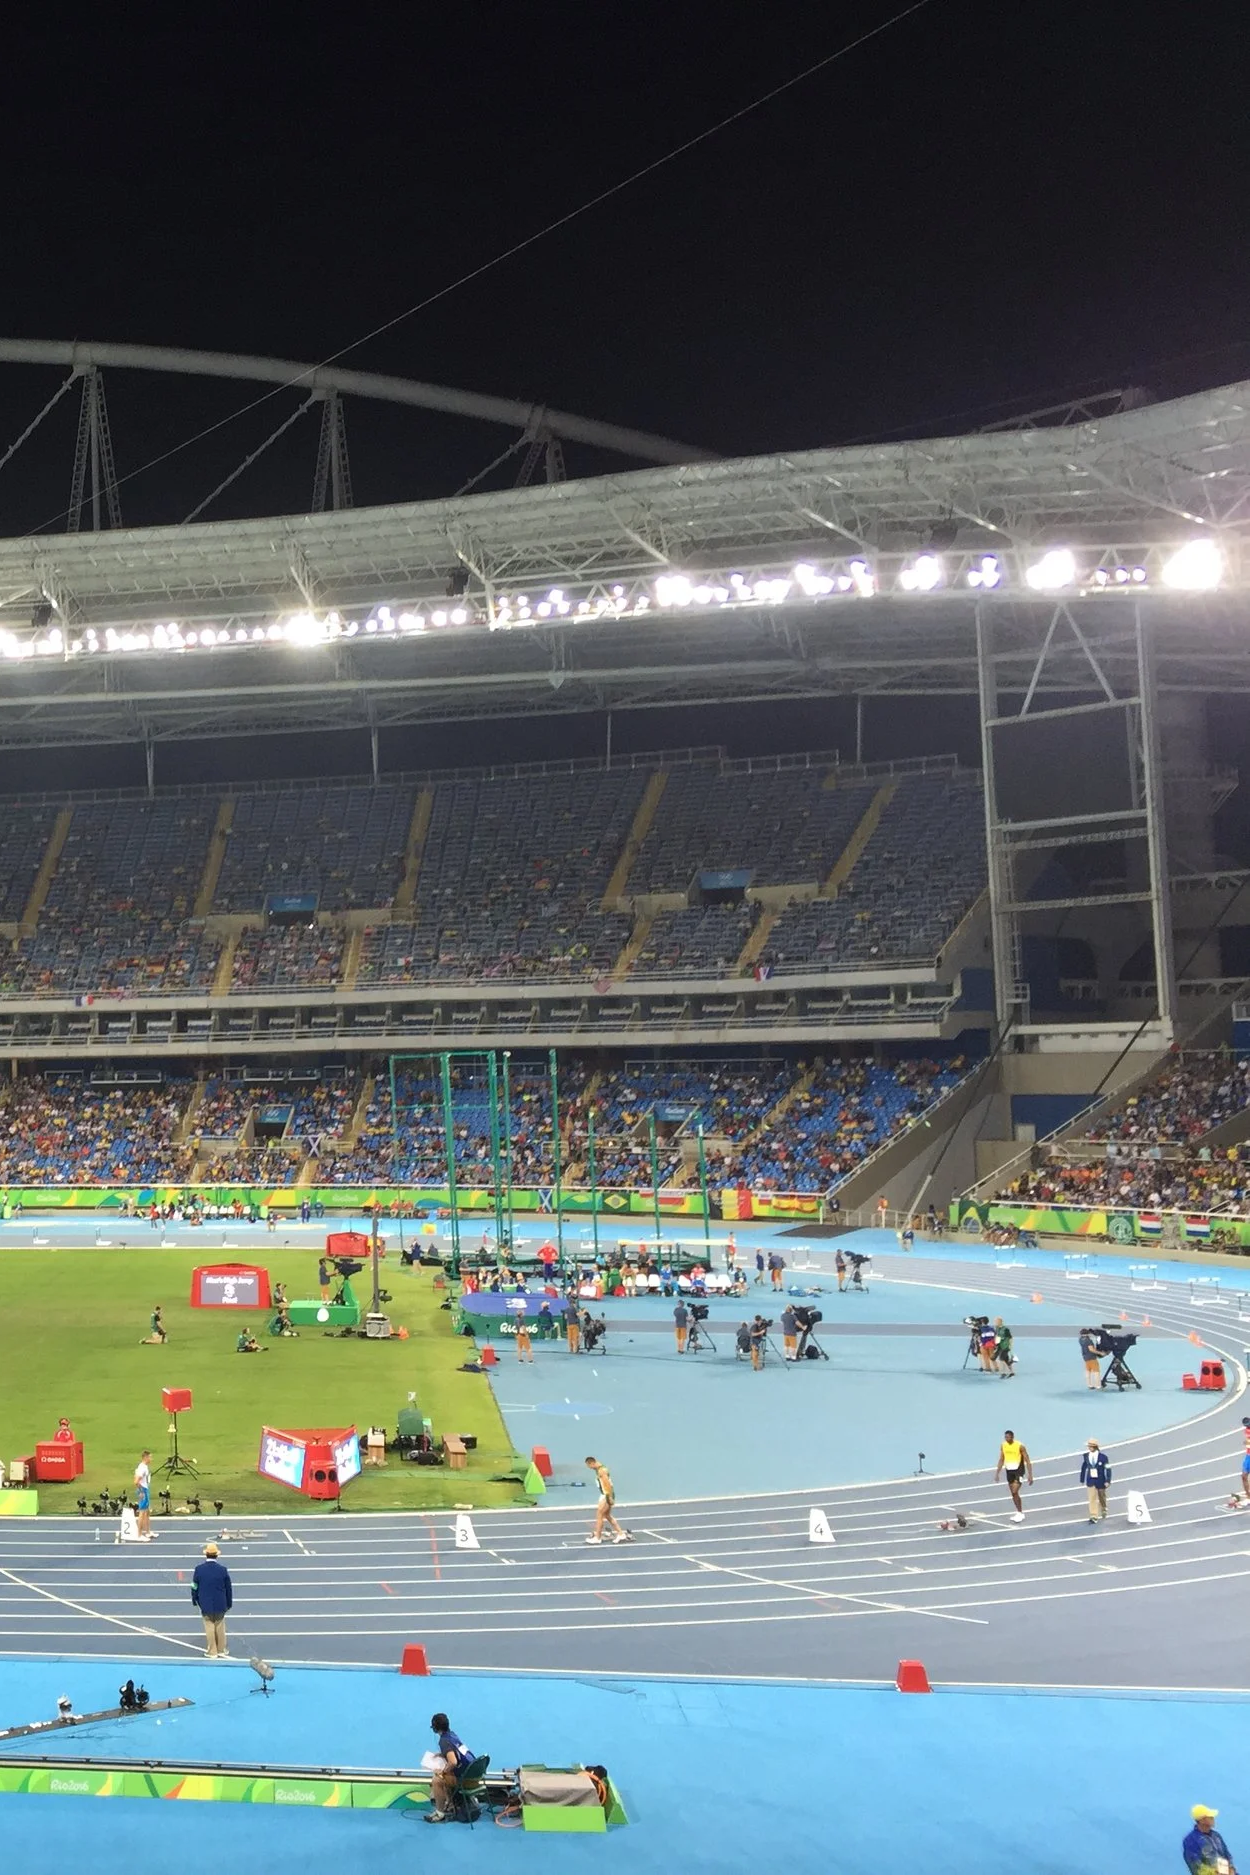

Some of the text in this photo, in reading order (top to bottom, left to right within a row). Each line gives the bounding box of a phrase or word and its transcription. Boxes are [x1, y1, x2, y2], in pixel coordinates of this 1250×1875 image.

[500, 1322, 538, 1334] Rio16
[1135, 1504, 1144, 1517] 5
[123, 1521, 131, 1535] 2
[814, 1523, 824, 1536] 4
[460, 1529, 469, 1542] 3
[51, 1779, 89, 1791] Rio2016
[275, 1789, 316, 1801] Rio2016
